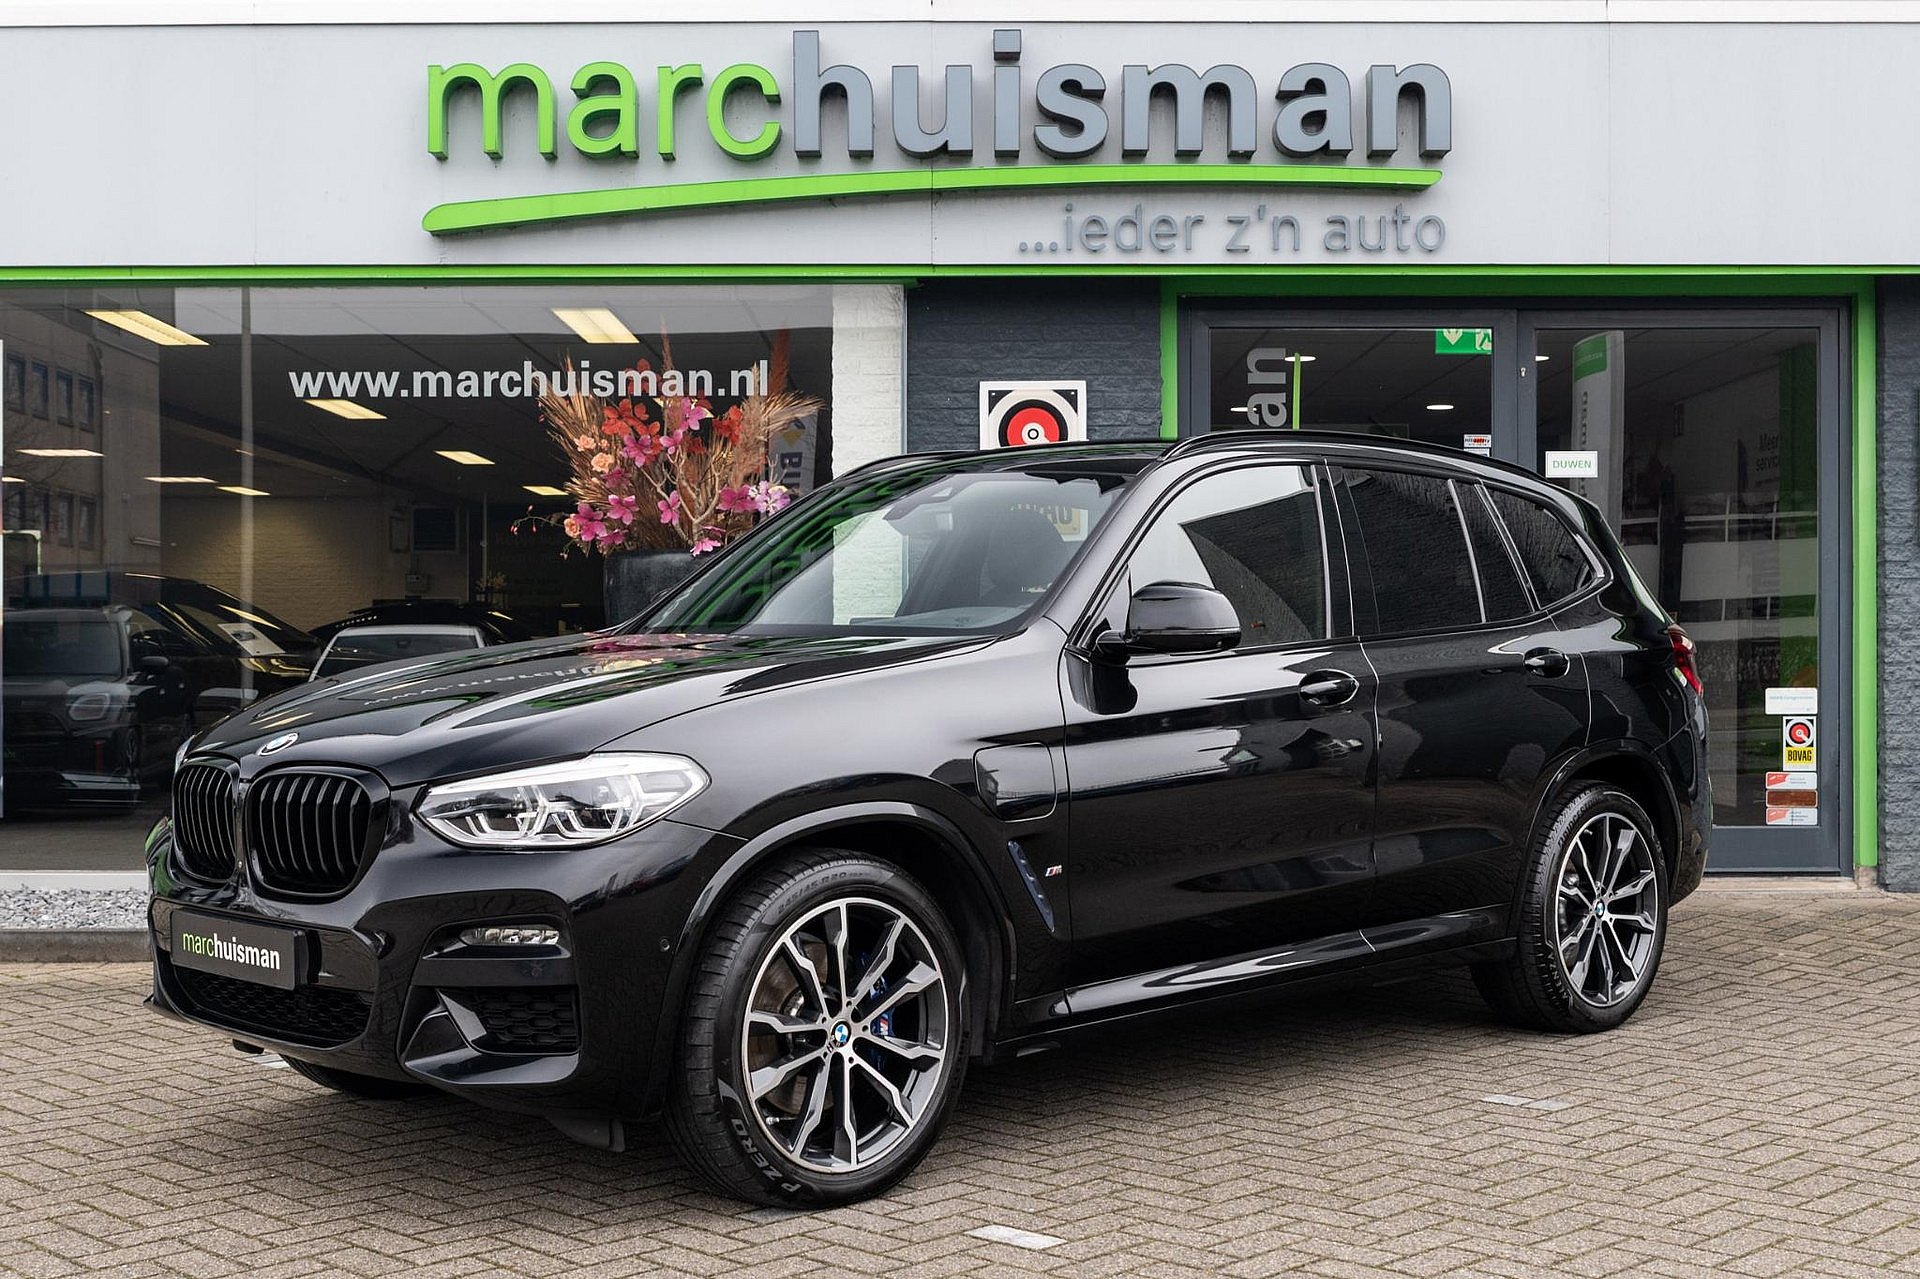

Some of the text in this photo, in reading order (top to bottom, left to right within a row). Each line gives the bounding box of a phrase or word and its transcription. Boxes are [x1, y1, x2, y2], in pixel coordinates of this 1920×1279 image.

[427, 30, 1452, 159] marchuisman
[1225, 203, 1300, 252] z'n
[1322, 203, 1446, 252] auto
[288, 360, 769, 398] www.marchuisman.nl
[1552, 460, 1592, 469] DUWEN
[1787, 750, 1812, 762] BOVAG
[182, 932, 281, 970] marchuisman
[730, 1118, 783, 1181] ZERO
